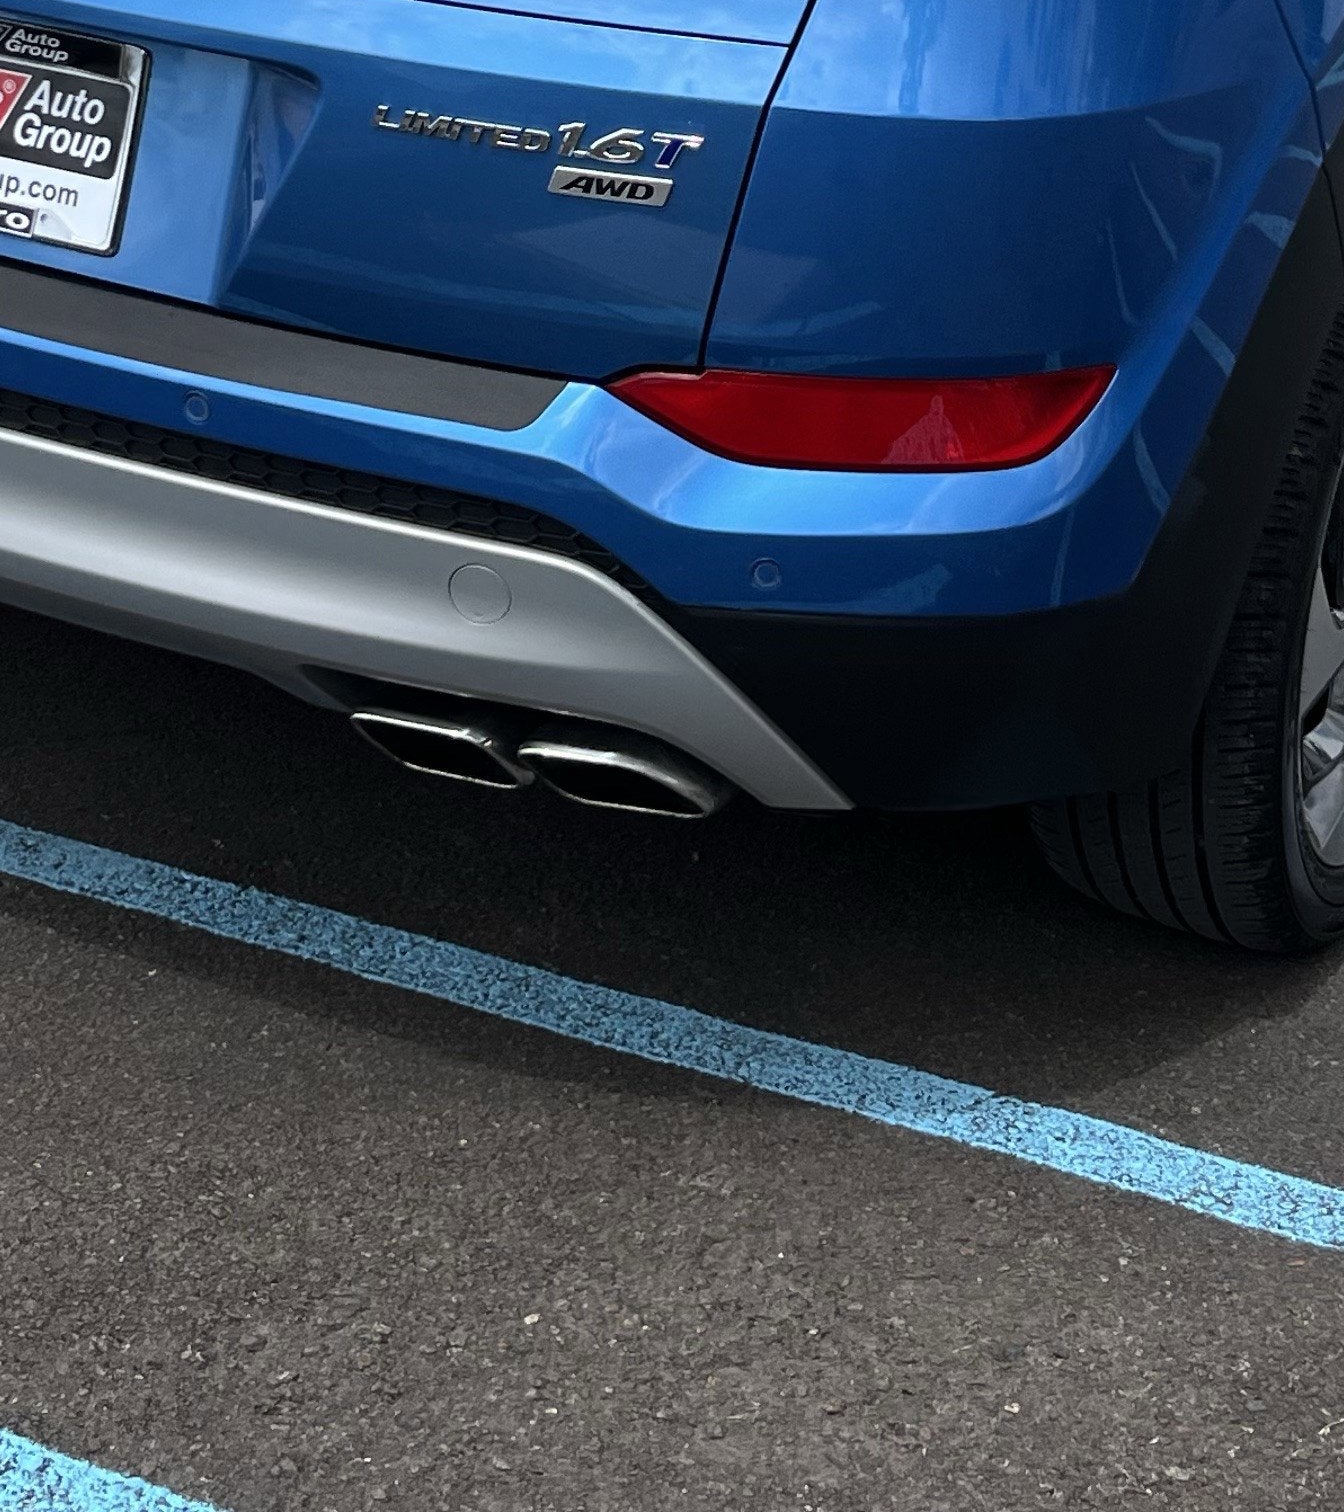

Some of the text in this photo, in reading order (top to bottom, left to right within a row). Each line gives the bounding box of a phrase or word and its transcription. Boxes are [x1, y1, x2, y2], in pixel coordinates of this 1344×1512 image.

[4, 39, 69, 63] Group
[12, 28, 61, 49] Auto
[23, 79, 106, 126] Auto
[12, 112, 112, 168] Group
[373, 104, 552, 153] LIMITED
[559, 175, 655, 201] AWD
